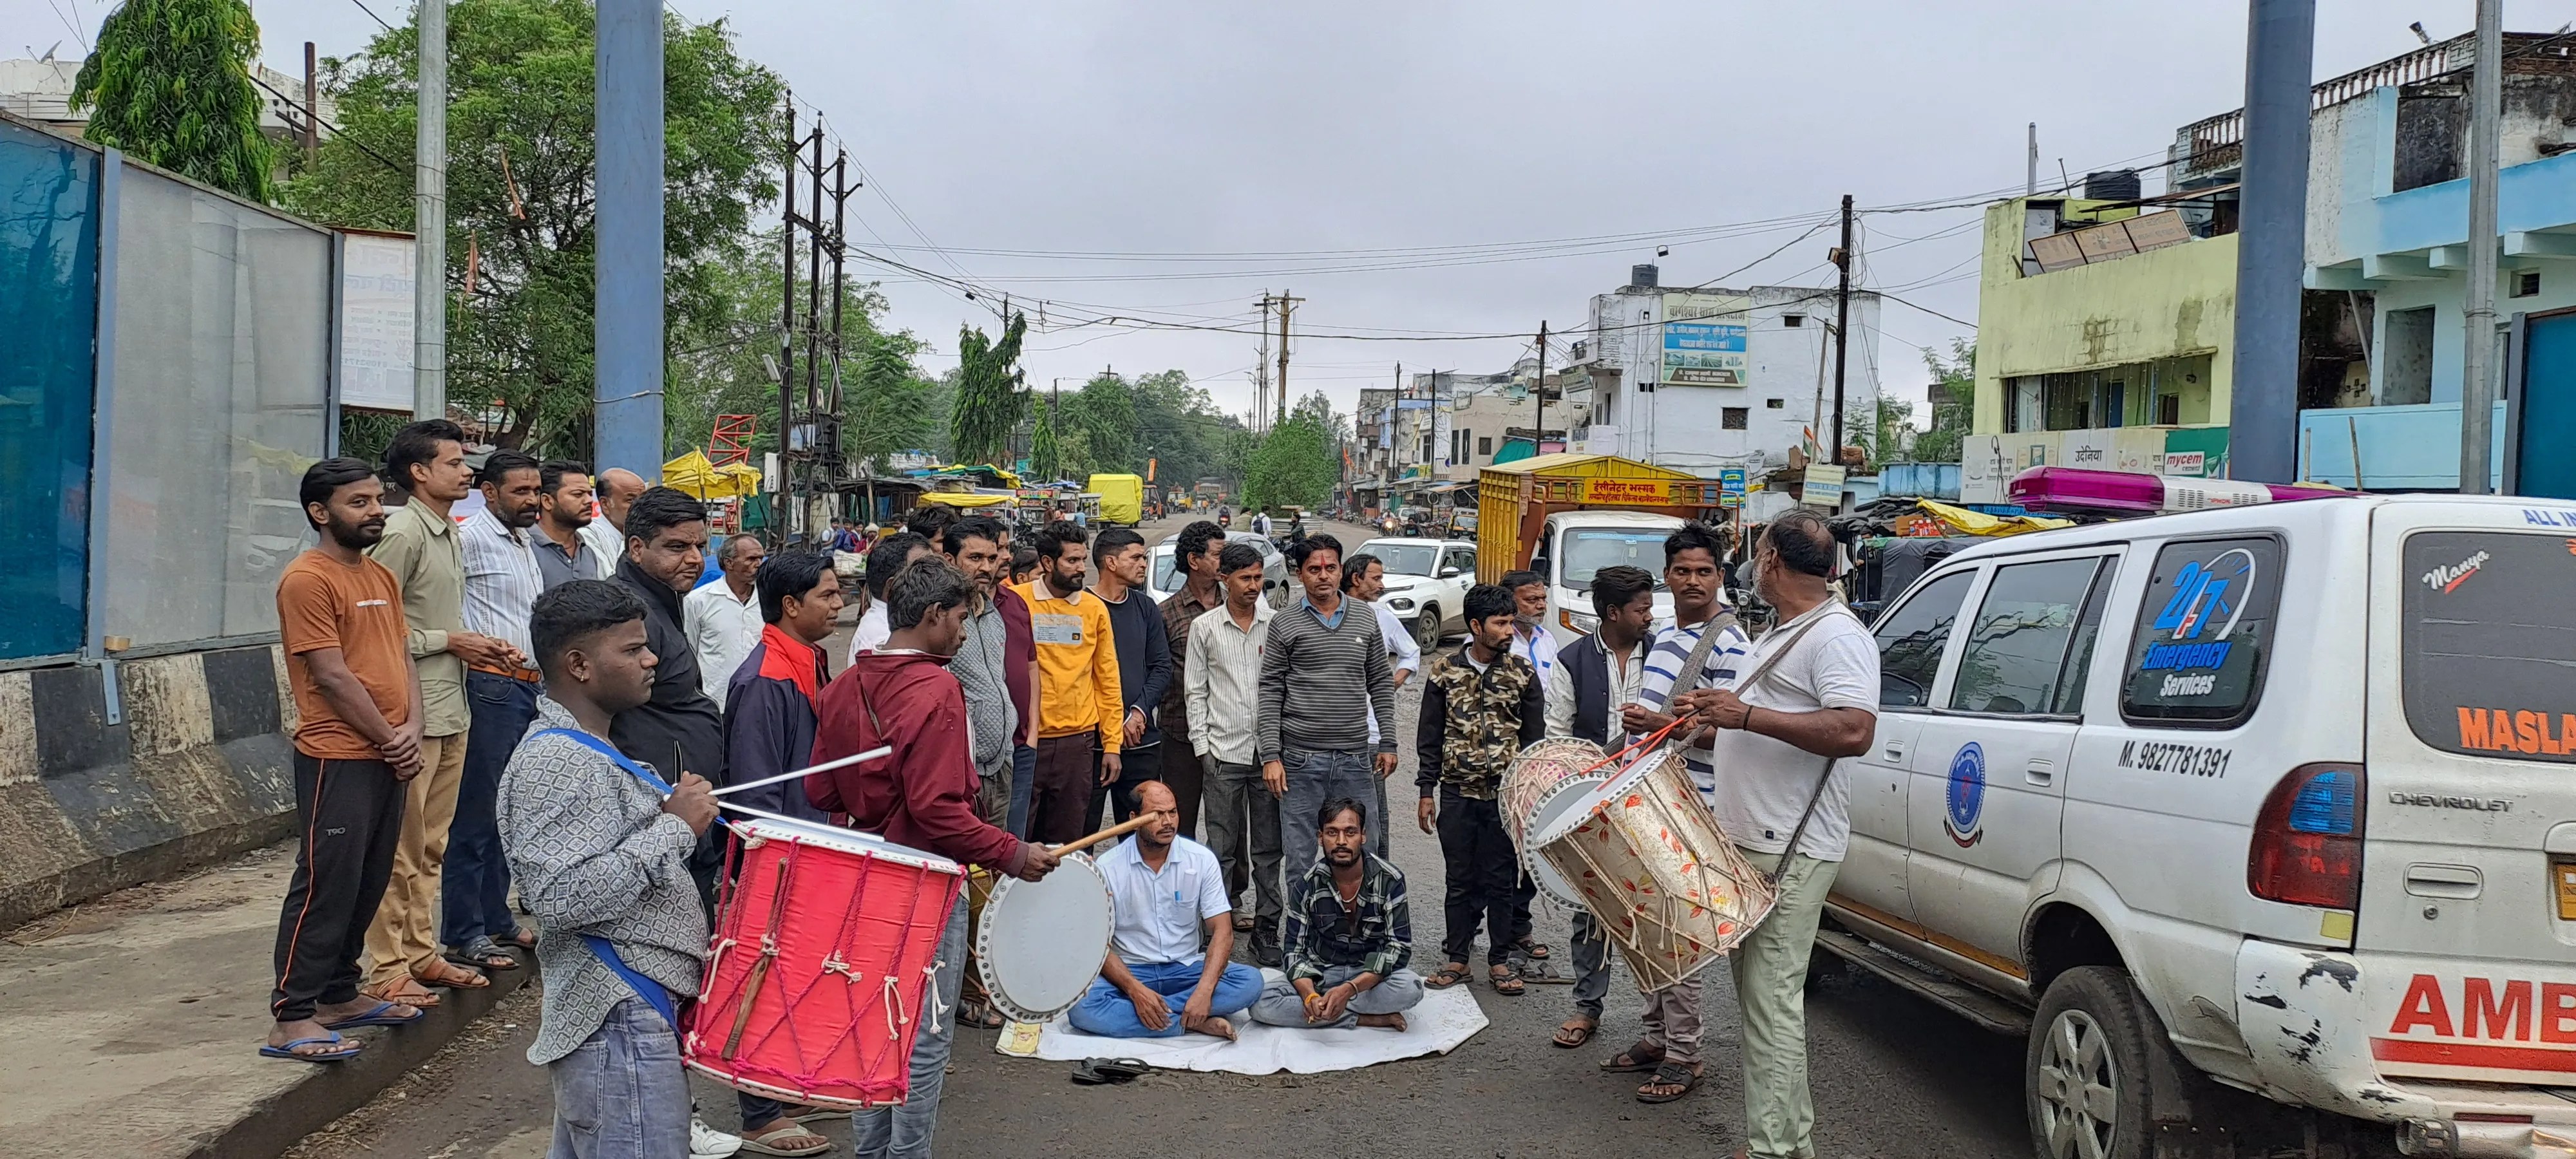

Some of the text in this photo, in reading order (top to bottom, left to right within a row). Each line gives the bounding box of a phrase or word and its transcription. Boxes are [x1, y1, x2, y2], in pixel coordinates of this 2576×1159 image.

[2166, 453, 2202, 467] mycem
[2523, 509, 2561, 526] ALL
[2421, 550, 2491, 590] Manya
[2141, 641, 2233, 672] Emergency
[2160, 672, 2216, 697] Services
[2456, 706, 2576, 755] MASLA
[2119, 740, 2233, 780] M. 9827781391
[2388, 791, 2514, 813] CHEVROLET
[2389, 973, 2576, 1044] AMB
